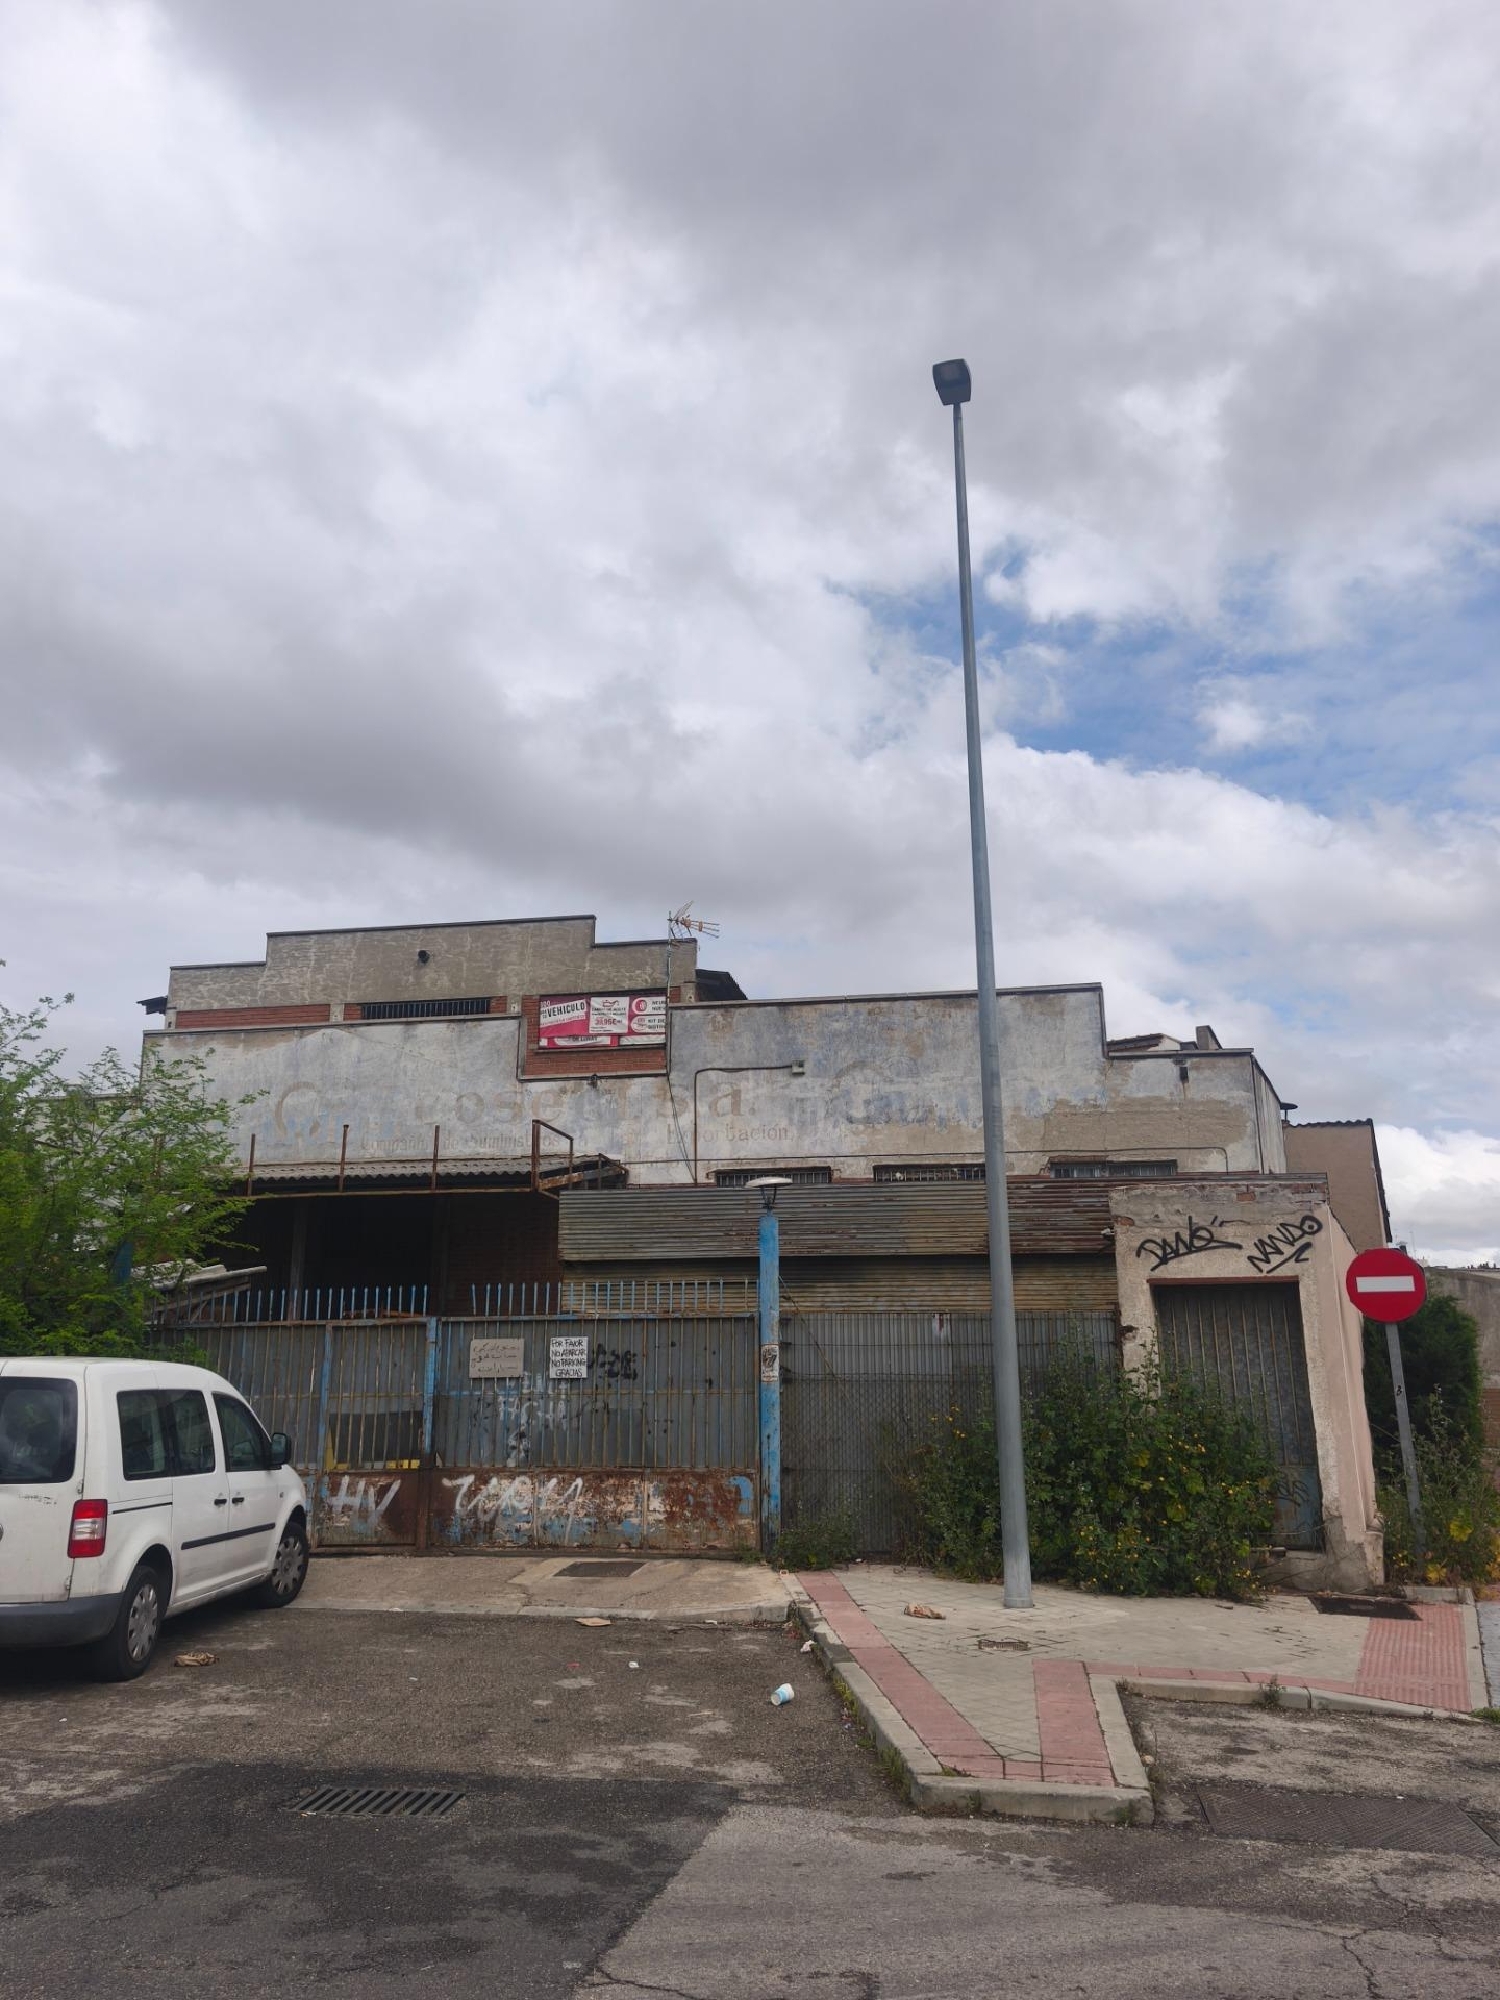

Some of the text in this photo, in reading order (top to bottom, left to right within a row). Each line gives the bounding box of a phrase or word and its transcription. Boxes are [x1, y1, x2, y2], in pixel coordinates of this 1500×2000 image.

[565, 1338, 584, 1348] FAVOR
[551, 1349, 561, 1357] NO
[551, 1359, 560, 1368] NO
[555, 1368, 583, 1378] GRACIAS
